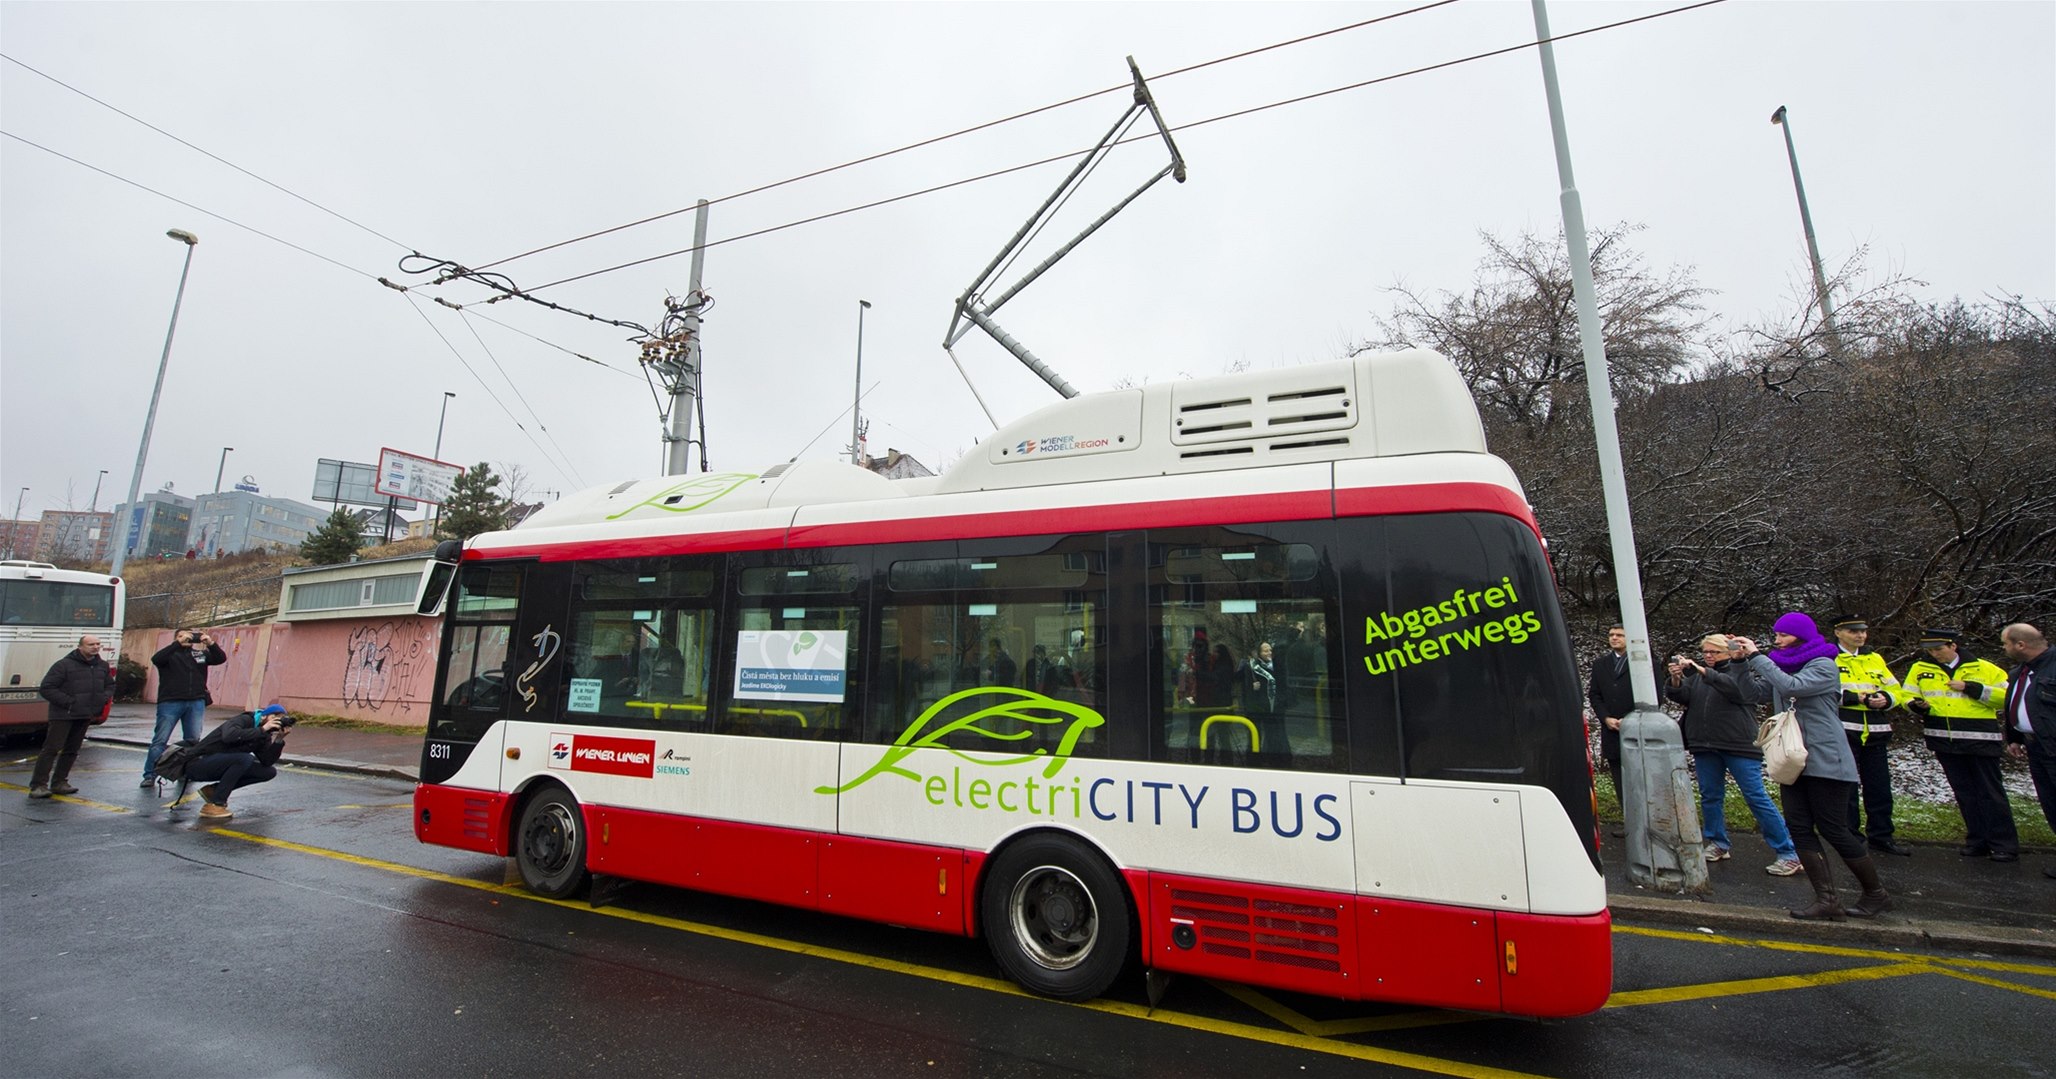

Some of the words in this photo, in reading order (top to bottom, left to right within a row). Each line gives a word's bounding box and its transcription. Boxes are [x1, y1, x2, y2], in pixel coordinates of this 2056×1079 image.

[1040, 435, 1074, 445] WIENER
[1040, 439, 1109, 453] MODELLREGION
[1365, 576, 1518, 645] Abgasfrei
[1363, 610, 1541, 675] unterwegs
[741, 669, 758, 680] Čistá
[758, 672, 779, 680] města
[780, 671, 792, 680] bez
[793, 672, 813, 681] hluku
[819, 673, 840, 682] emisí
[760, 682, 787, 691] EKOlogicky
[430, 743, 450, 759] 8311
[575, 748, 616, 762] WIENER
[616, 751, 651, 764] LINIEN
[656, 765, 690, 775] SIEMENS
[1231, 787, 1342, 841] BUS
